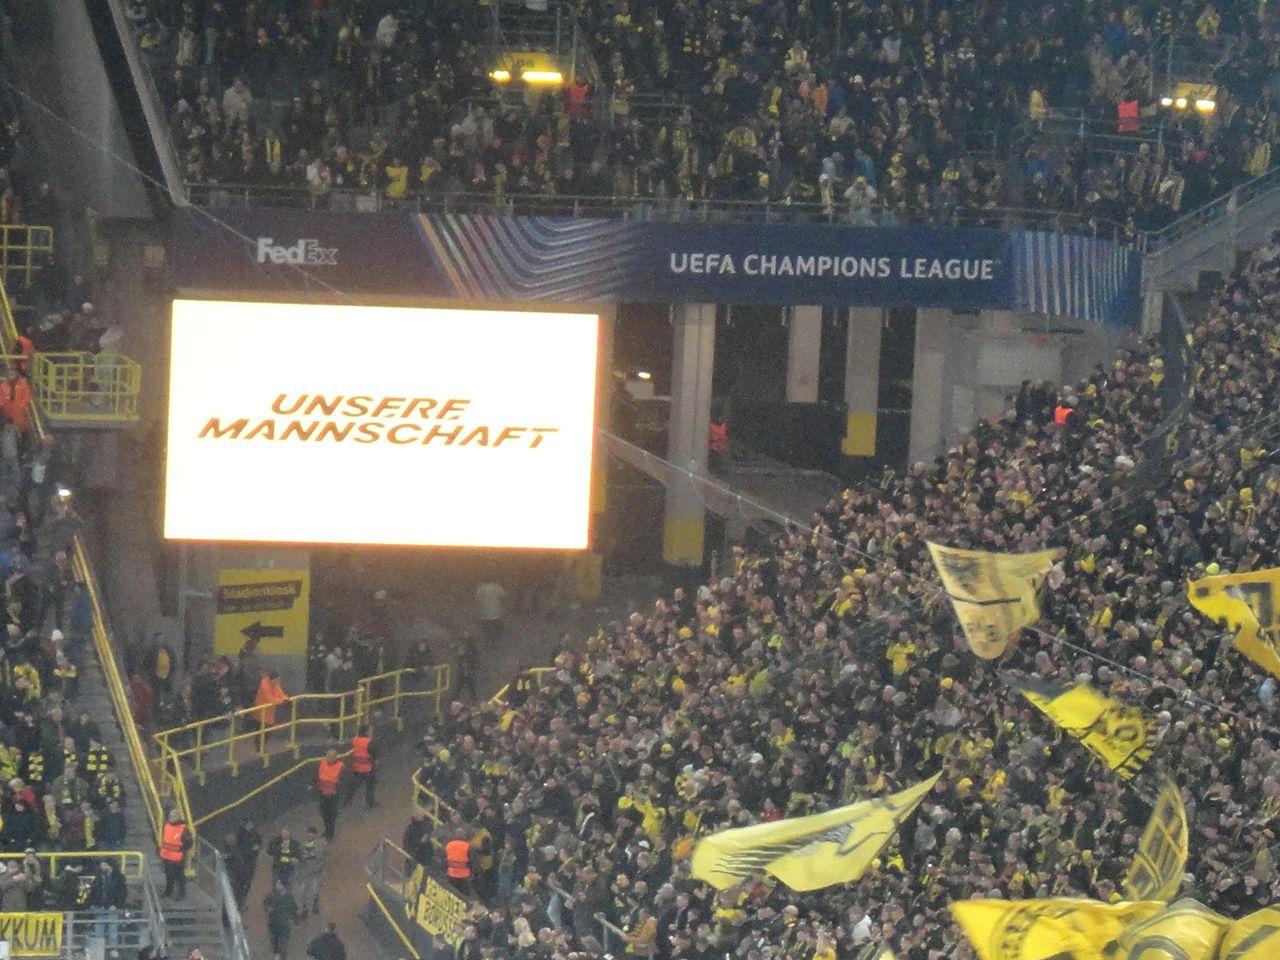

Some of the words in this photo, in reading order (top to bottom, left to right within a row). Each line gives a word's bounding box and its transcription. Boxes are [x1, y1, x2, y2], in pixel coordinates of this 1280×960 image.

[257, 238, 338, 265] FedEx
[670, 253, 735, 275] UEFA
[743, 254, 890, 278] CHAMPIONS
[900, 257, 993, 281] LEAGUE
[271, 393, 471, 420] UNSERE
[198, 417, 559, 449] MANNSCHAFT
